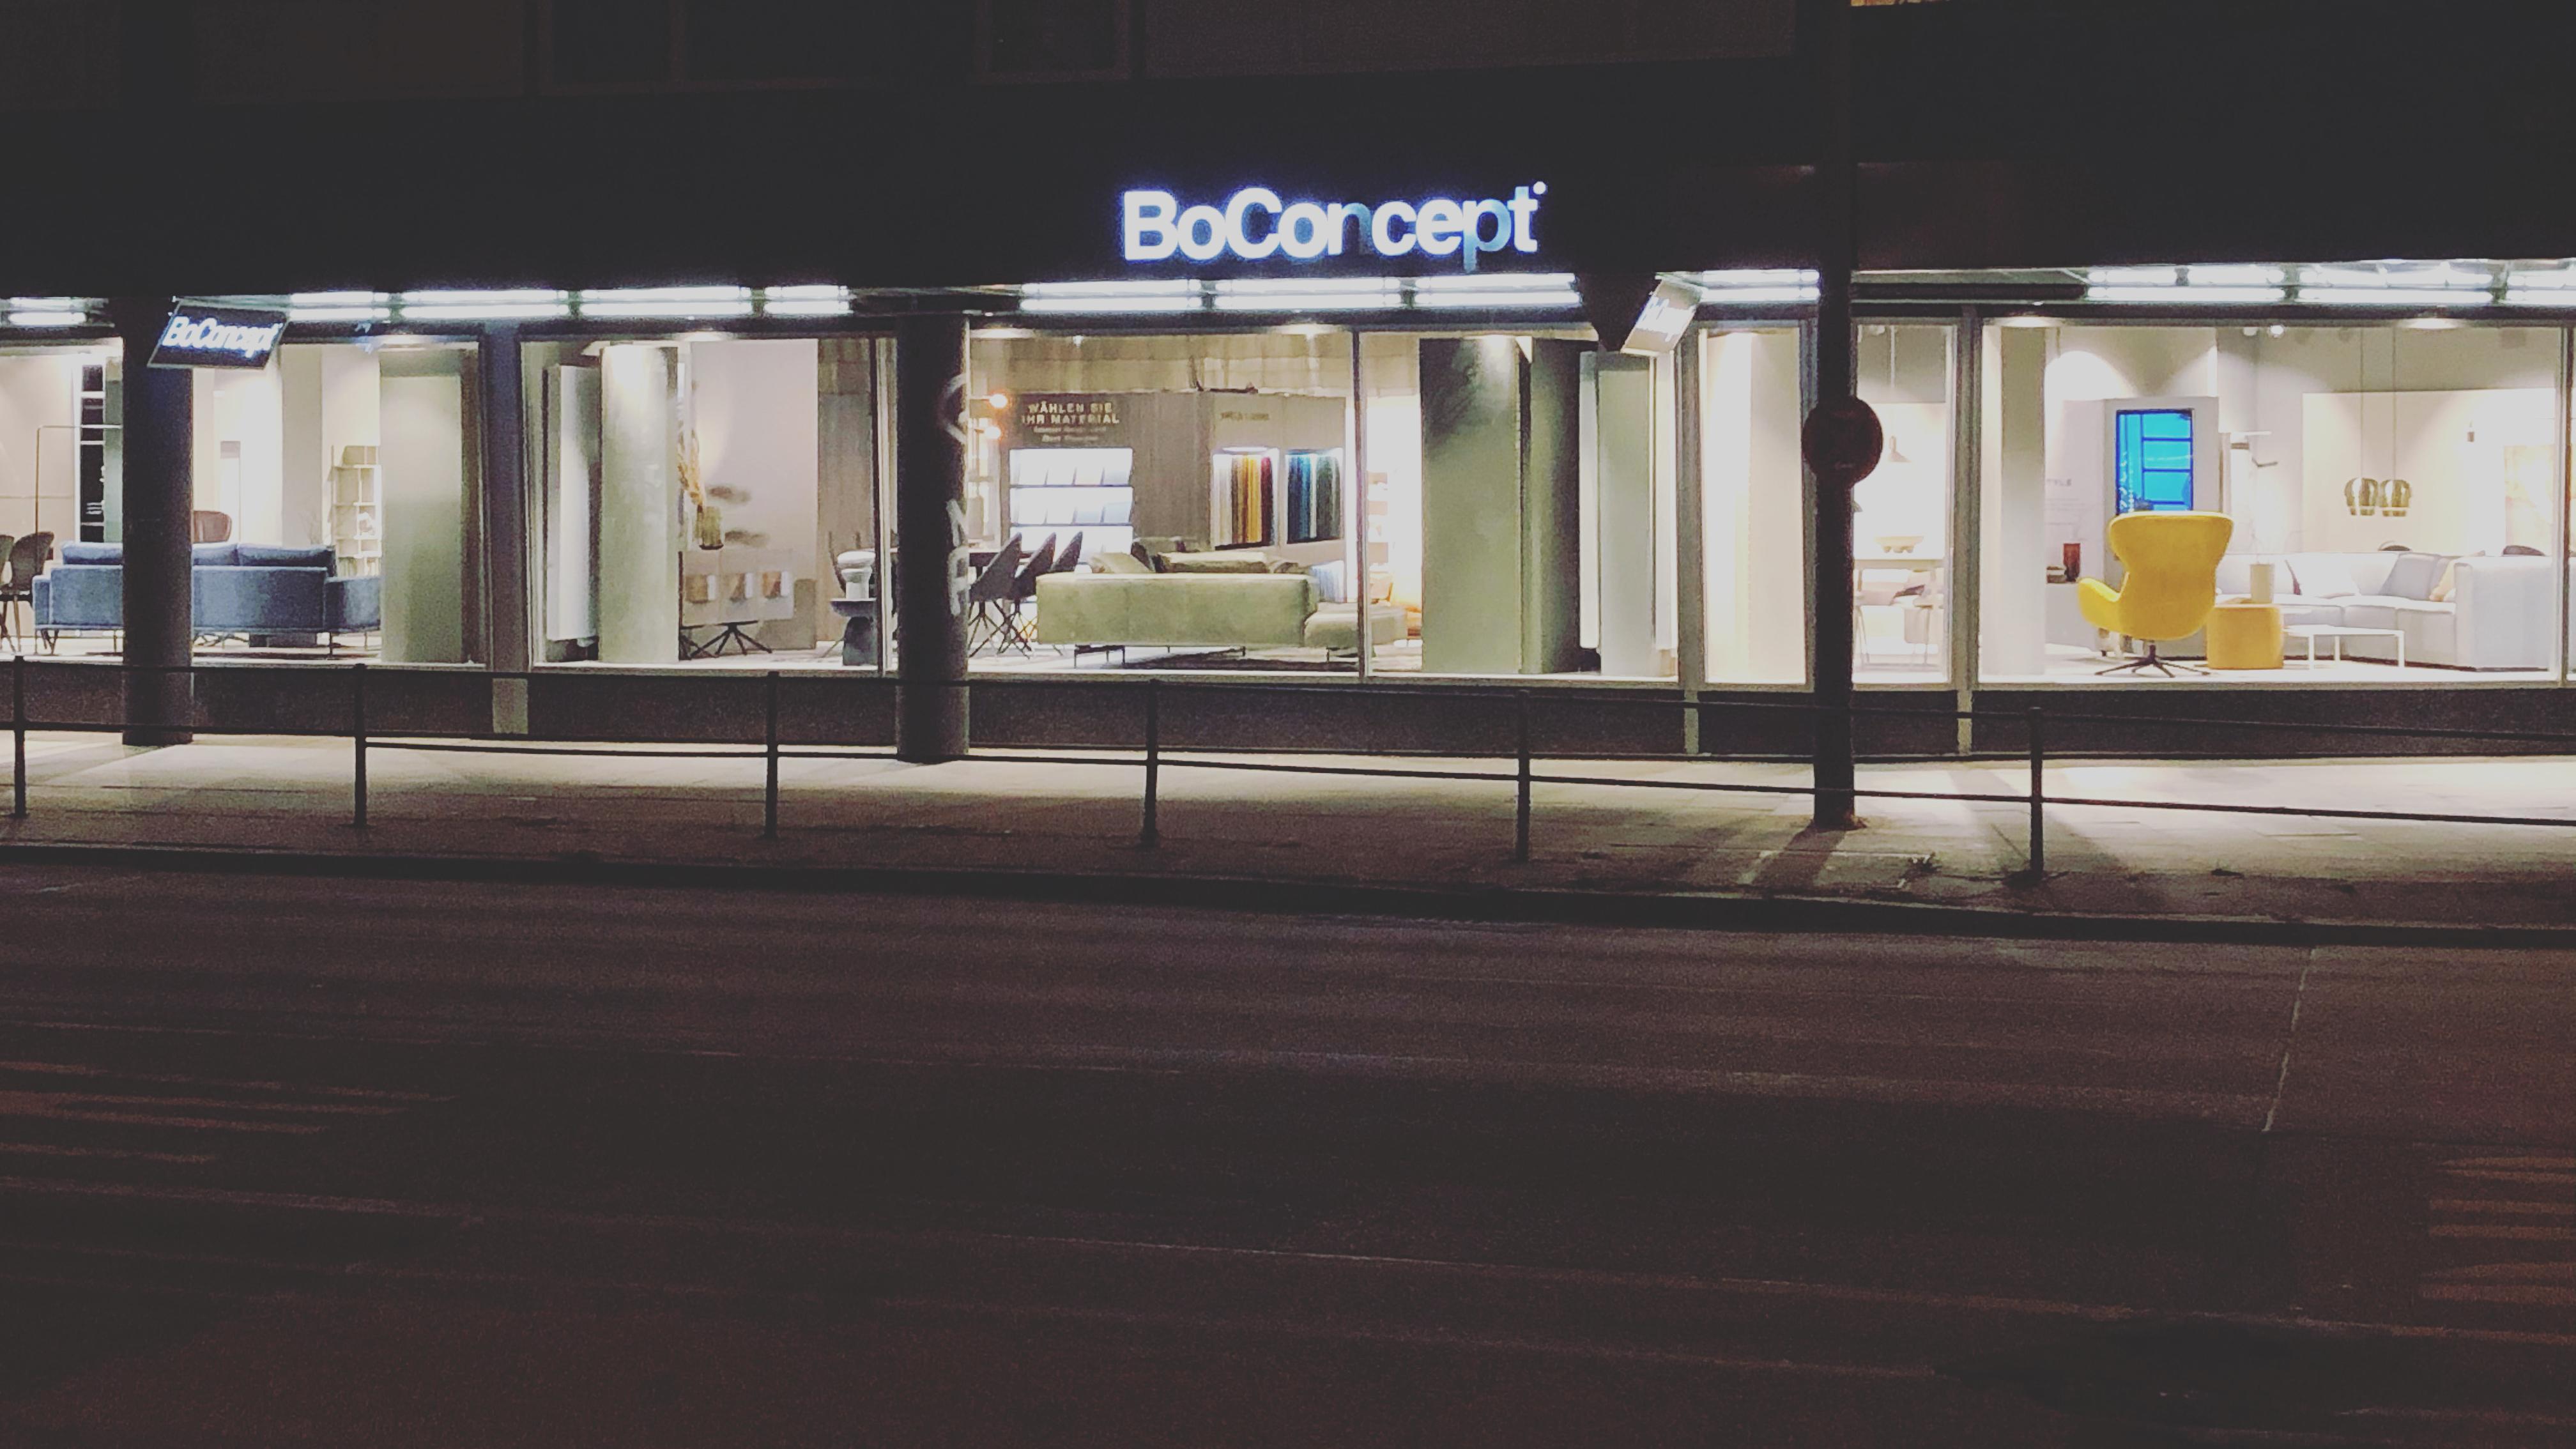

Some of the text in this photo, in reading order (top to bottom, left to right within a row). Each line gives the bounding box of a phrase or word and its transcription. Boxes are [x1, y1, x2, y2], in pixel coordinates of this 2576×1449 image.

[1123, 186, 1539, 272] BoConcept
[162, 316, 283, 358] BoConcept
[1022, 414, 1119, 424] IHR MATERIAL
[1090, 402, 1112, 413] SIE
